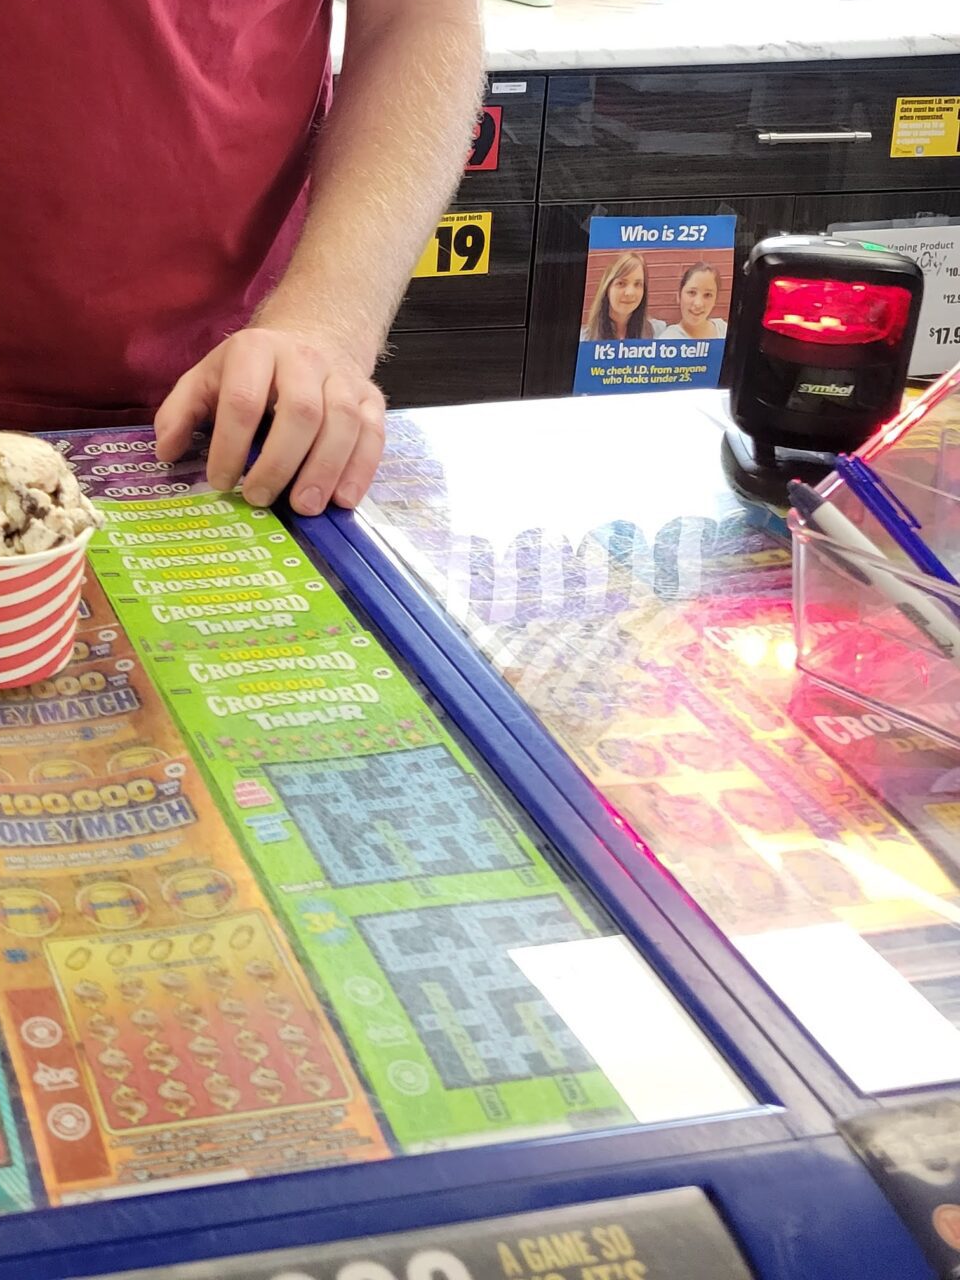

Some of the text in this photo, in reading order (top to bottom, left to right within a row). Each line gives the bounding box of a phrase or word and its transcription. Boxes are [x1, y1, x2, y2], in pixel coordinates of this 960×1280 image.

[468, 214, 482, 222] birth
[620, 225, 707, 242] Who is 25?
[435, 224, 486, 272] 19
[920, 241, 954, 251] Product
[594, 342, 709, 360] It's hard to tell!
[591, 365, 707, 376] We check I.D. from anyone
[602, 373, 693, 385] who looks under 25.
[799, 383, 855, 395] symbol
[91, 461, 175, 476] BINGO
[105, 483, 190, 498] BINGO
[151, 594, 310, 624] CROSSWORD
[188, 651, 357, 684] CROSSWORD
[36, 689, 140, 725] MATCH
[81, 798, 192, 843] MATCH
[518, 1230, 599, 1272] GAME
[591, 1224, 636, 1261] SO
[496, 1241, 524, 1276] A
